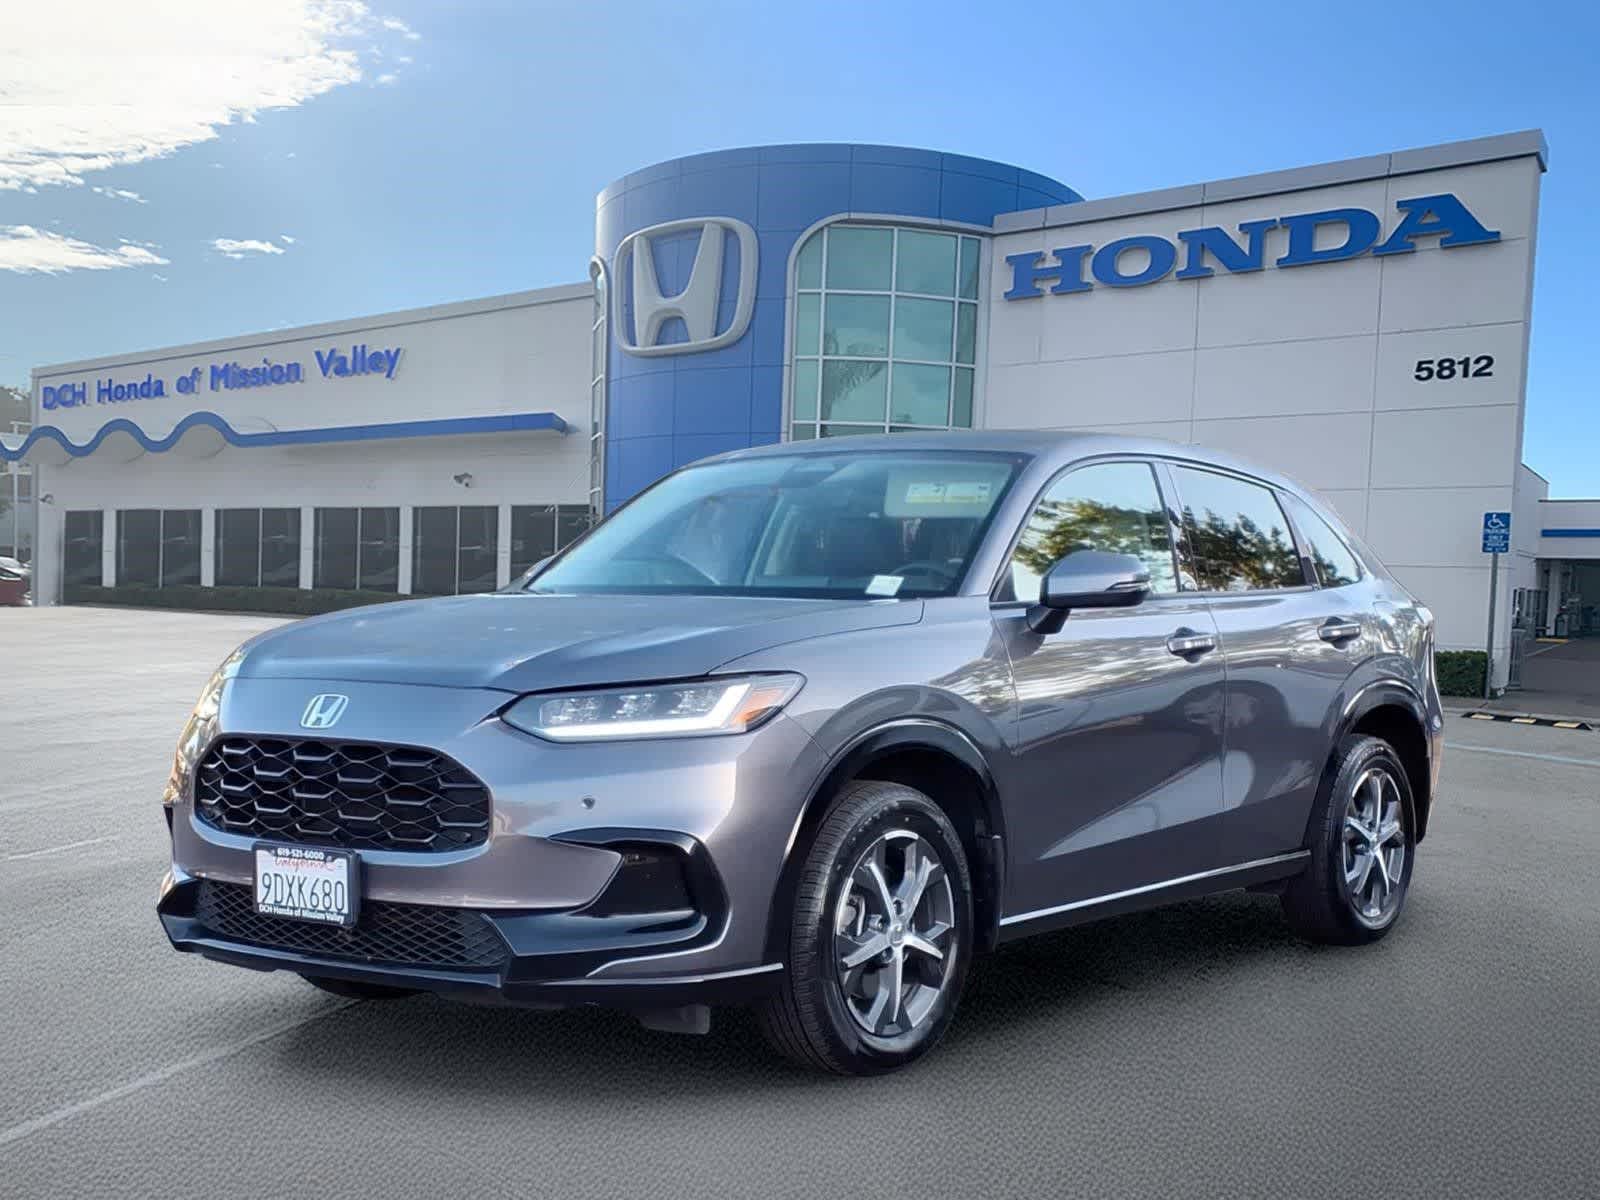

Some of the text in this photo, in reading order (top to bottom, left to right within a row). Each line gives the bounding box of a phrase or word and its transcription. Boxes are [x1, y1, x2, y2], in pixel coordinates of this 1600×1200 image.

[1004, 193, 1500, 300] HONDA
[42, 344, 402, 410] DCH Honda of Mission Valley
[1414, 354, 1495, 382] 5812
[262, 872, 345, 912] 9DXK680
